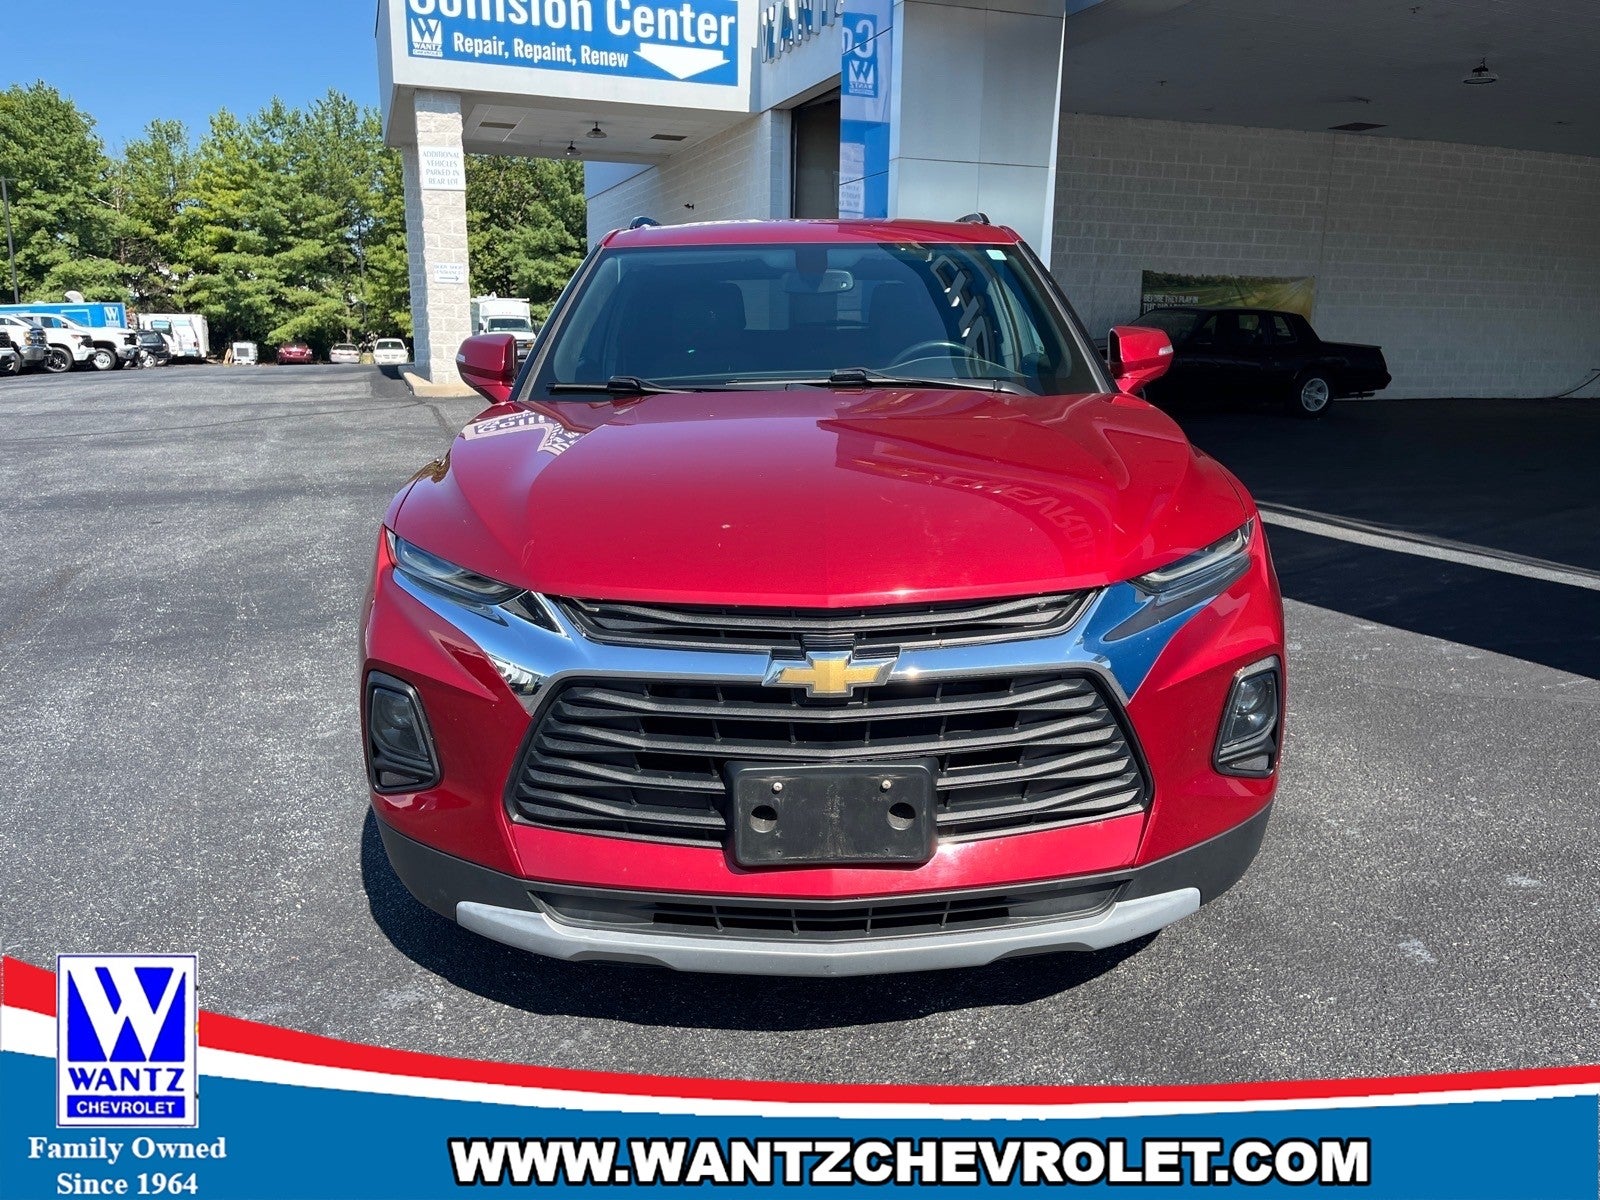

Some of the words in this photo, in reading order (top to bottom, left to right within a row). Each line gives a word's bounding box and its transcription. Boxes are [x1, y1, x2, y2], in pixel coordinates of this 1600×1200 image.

[606, 0, 737, 47] Center
[453, 32, 509, 59] Repair,
[513, 38, 577, 66] Repaint,
[581, 45, 629, 68] Renew
[422, 151, 460, 159] ADDITIONAL
[426, 160, 458, 168] VEHICLES
[428, 177, 445, 185] REAR
